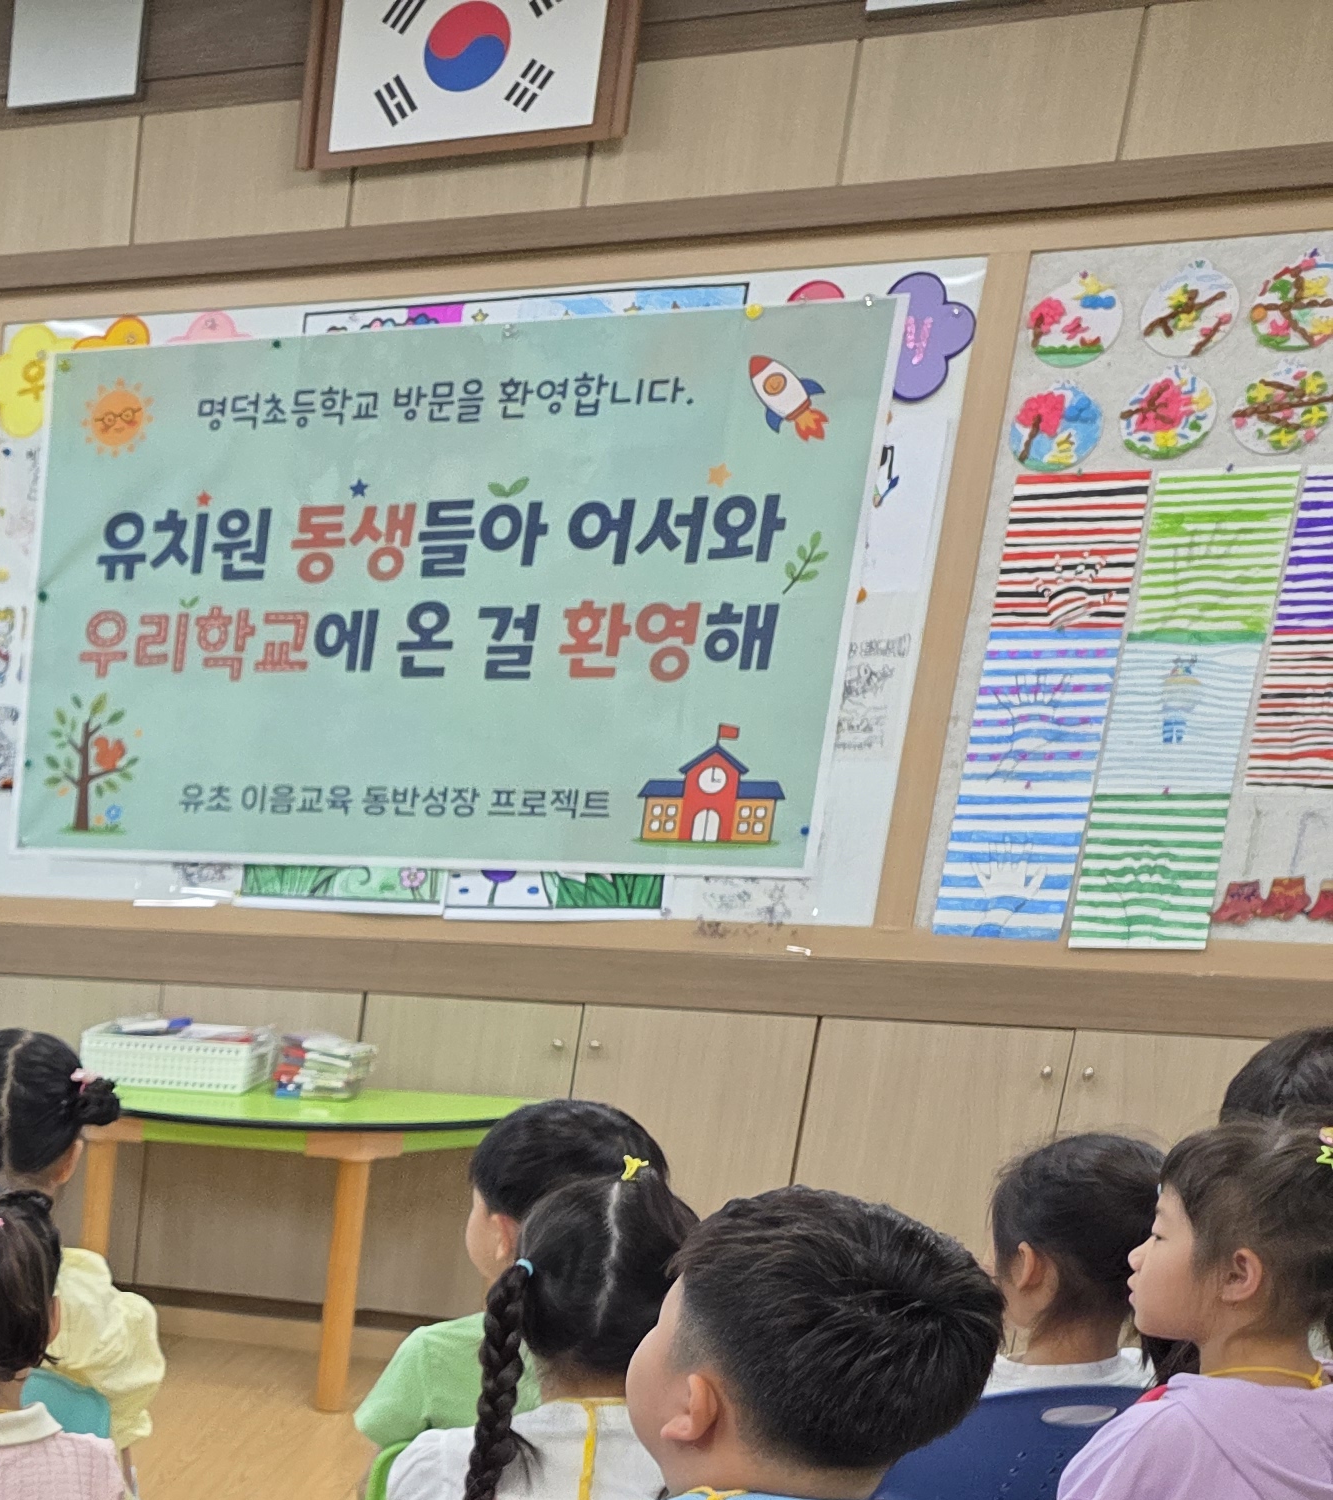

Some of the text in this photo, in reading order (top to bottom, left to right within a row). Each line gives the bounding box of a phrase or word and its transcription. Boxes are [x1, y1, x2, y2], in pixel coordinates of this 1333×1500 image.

[197, 371, 694, 432] 명덕초등학교 방문을 환영합니다.
[96, 493, 787, 585] 유치원 동생들아 어서와
[80, 600, 781, 683] 우리학교에 온 걸 환영해
[178, 782, 610, 820] 유초 이음교육 동반성장 프로젝트
